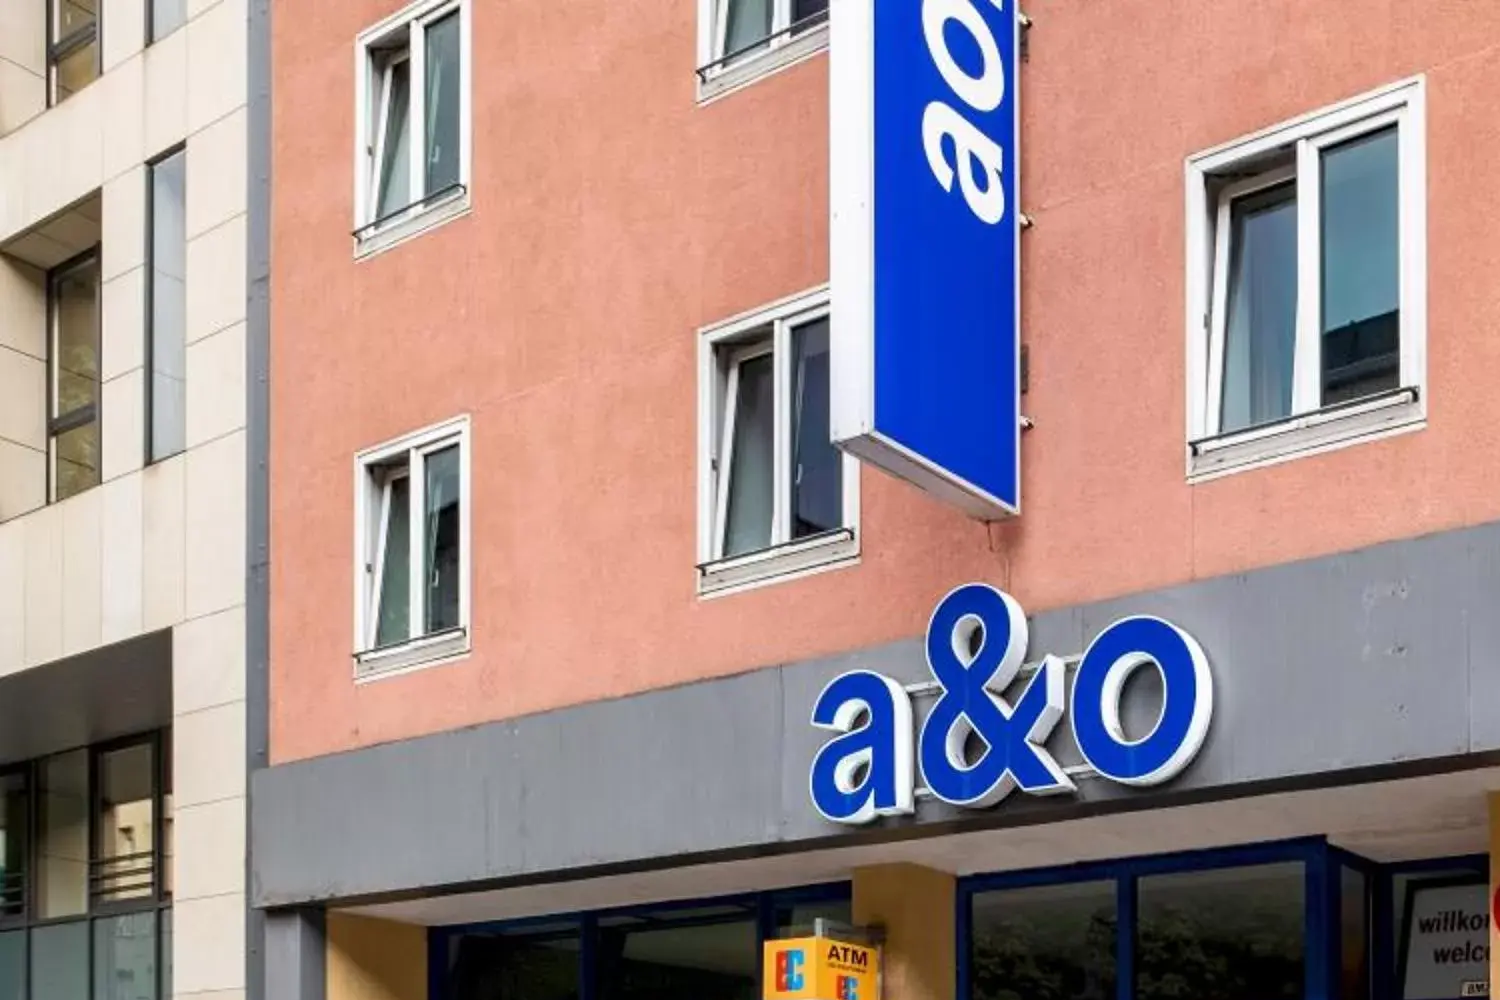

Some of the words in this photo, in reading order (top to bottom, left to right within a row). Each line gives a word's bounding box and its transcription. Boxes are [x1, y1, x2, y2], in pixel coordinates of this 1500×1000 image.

[922, 0, 1004, 224] ao
[809, 583, 1213, 825] a&o
[827, 945, 868, 967] ATM
